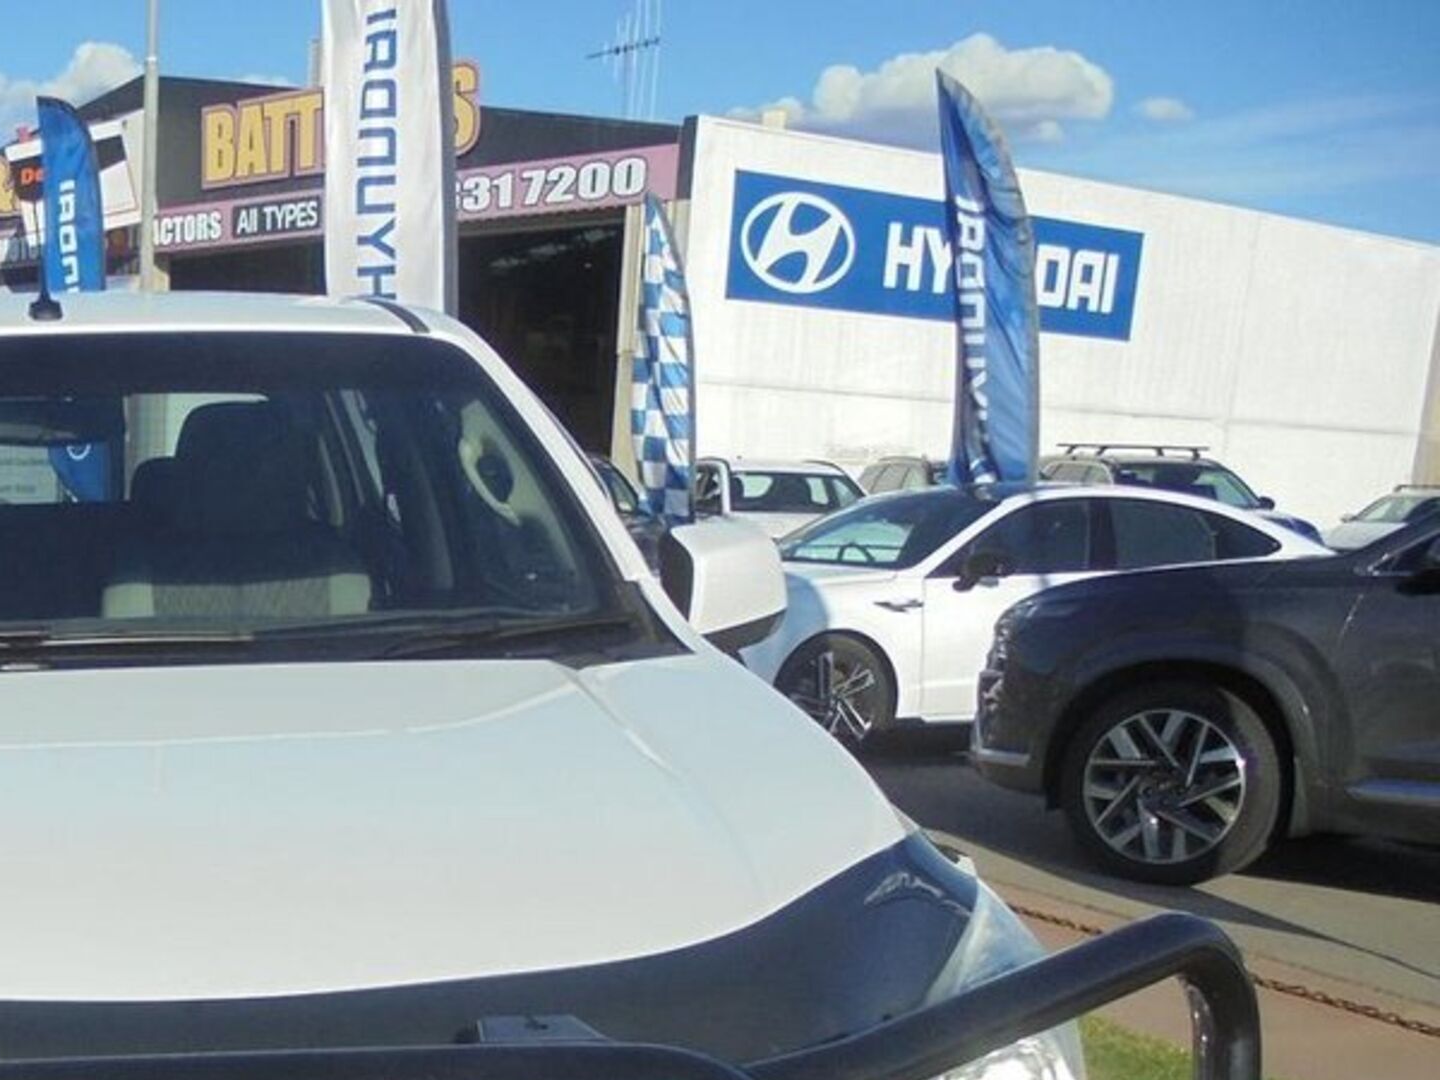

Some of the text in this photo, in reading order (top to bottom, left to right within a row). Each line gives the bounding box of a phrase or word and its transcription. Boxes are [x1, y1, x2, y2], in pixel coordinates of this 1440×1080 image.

[237, 207, 258, 234] All
[263, 201, 318, 231] TYPES
[522, 157, 647, 206] 7200
[883, 221, 1120, 314] HYDAI
